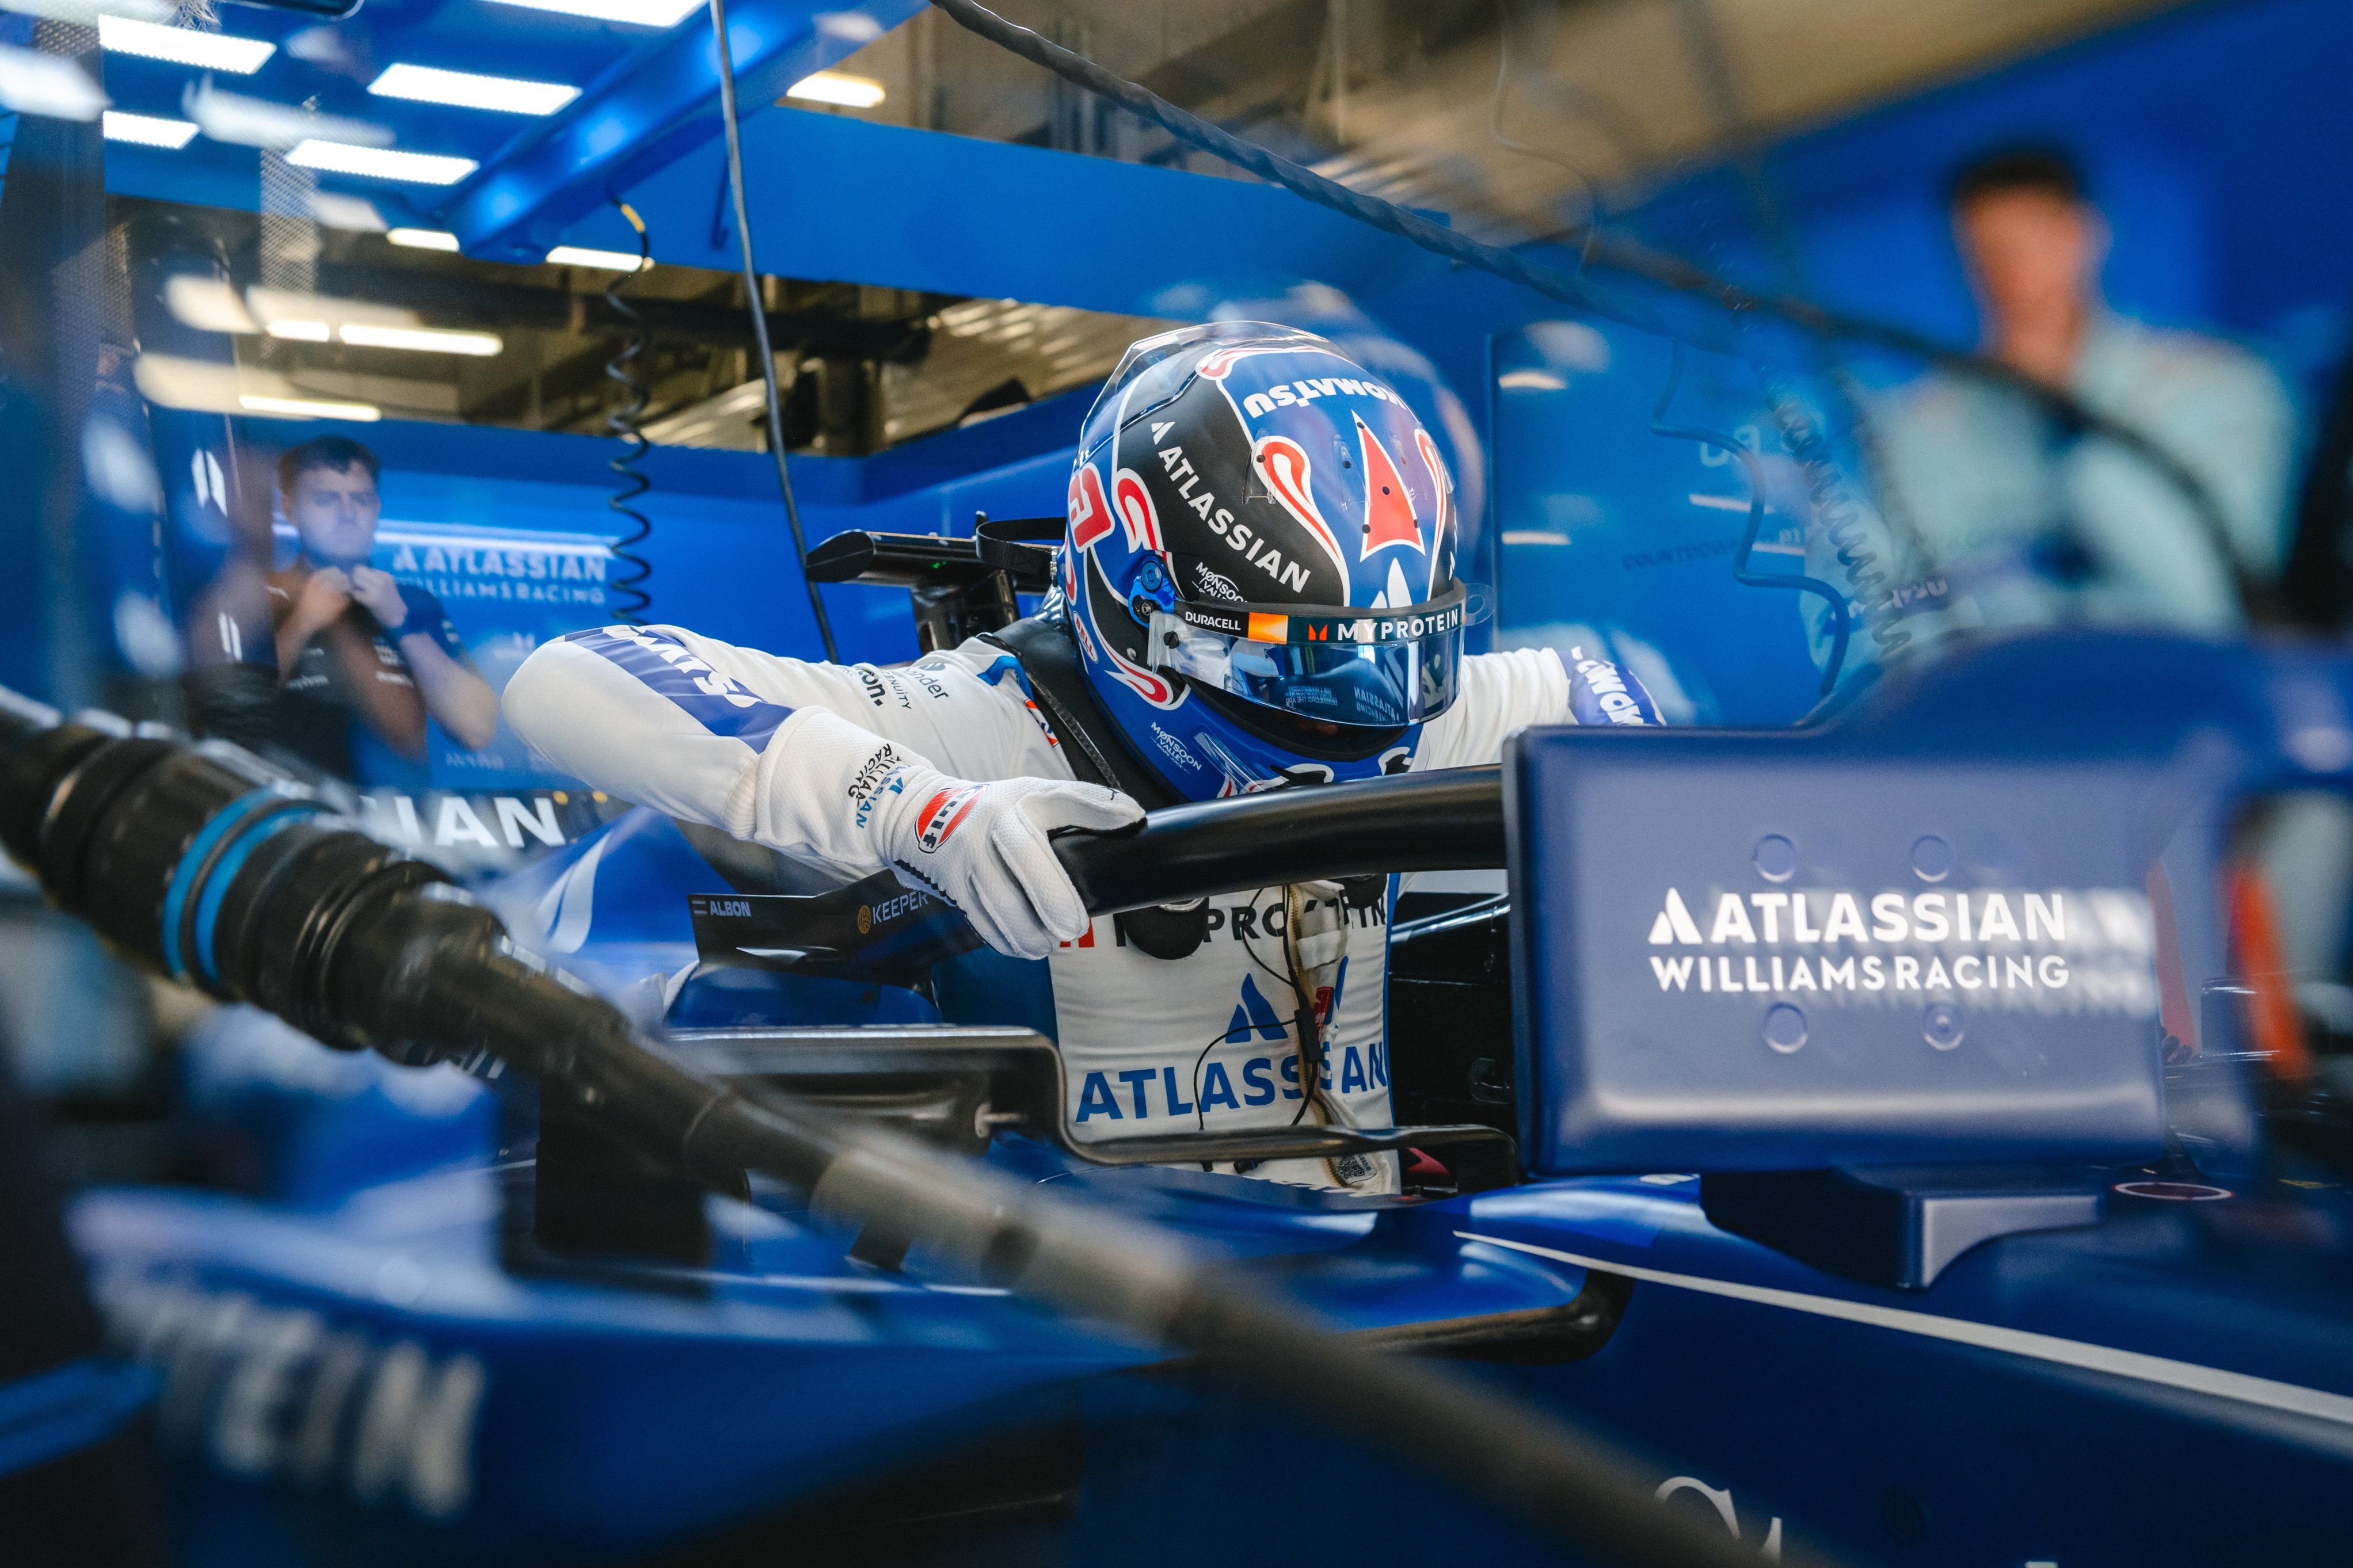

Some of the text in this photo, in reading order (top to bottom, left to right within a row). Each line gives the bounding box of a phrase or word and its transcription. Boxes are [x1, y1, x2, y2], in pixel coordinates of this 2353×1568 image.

[1158, 446, 1311, 593] ATLASSIAN
[516, 582, 605, 605] RACING
[1185, 611, 1241, 631] DURACELL
[1338, 608, 1459, 641] MYPROTEIN
[1151, 722, 1202, 770] MONSOON
[1160, 738, 1186, 764] VALLEY
[710, 901, 751, 917] ALBON
[1711, 893, 2065, 944] ATLASSIAN
[1650, 955, 2069, 993] WILLIAMS RACING
